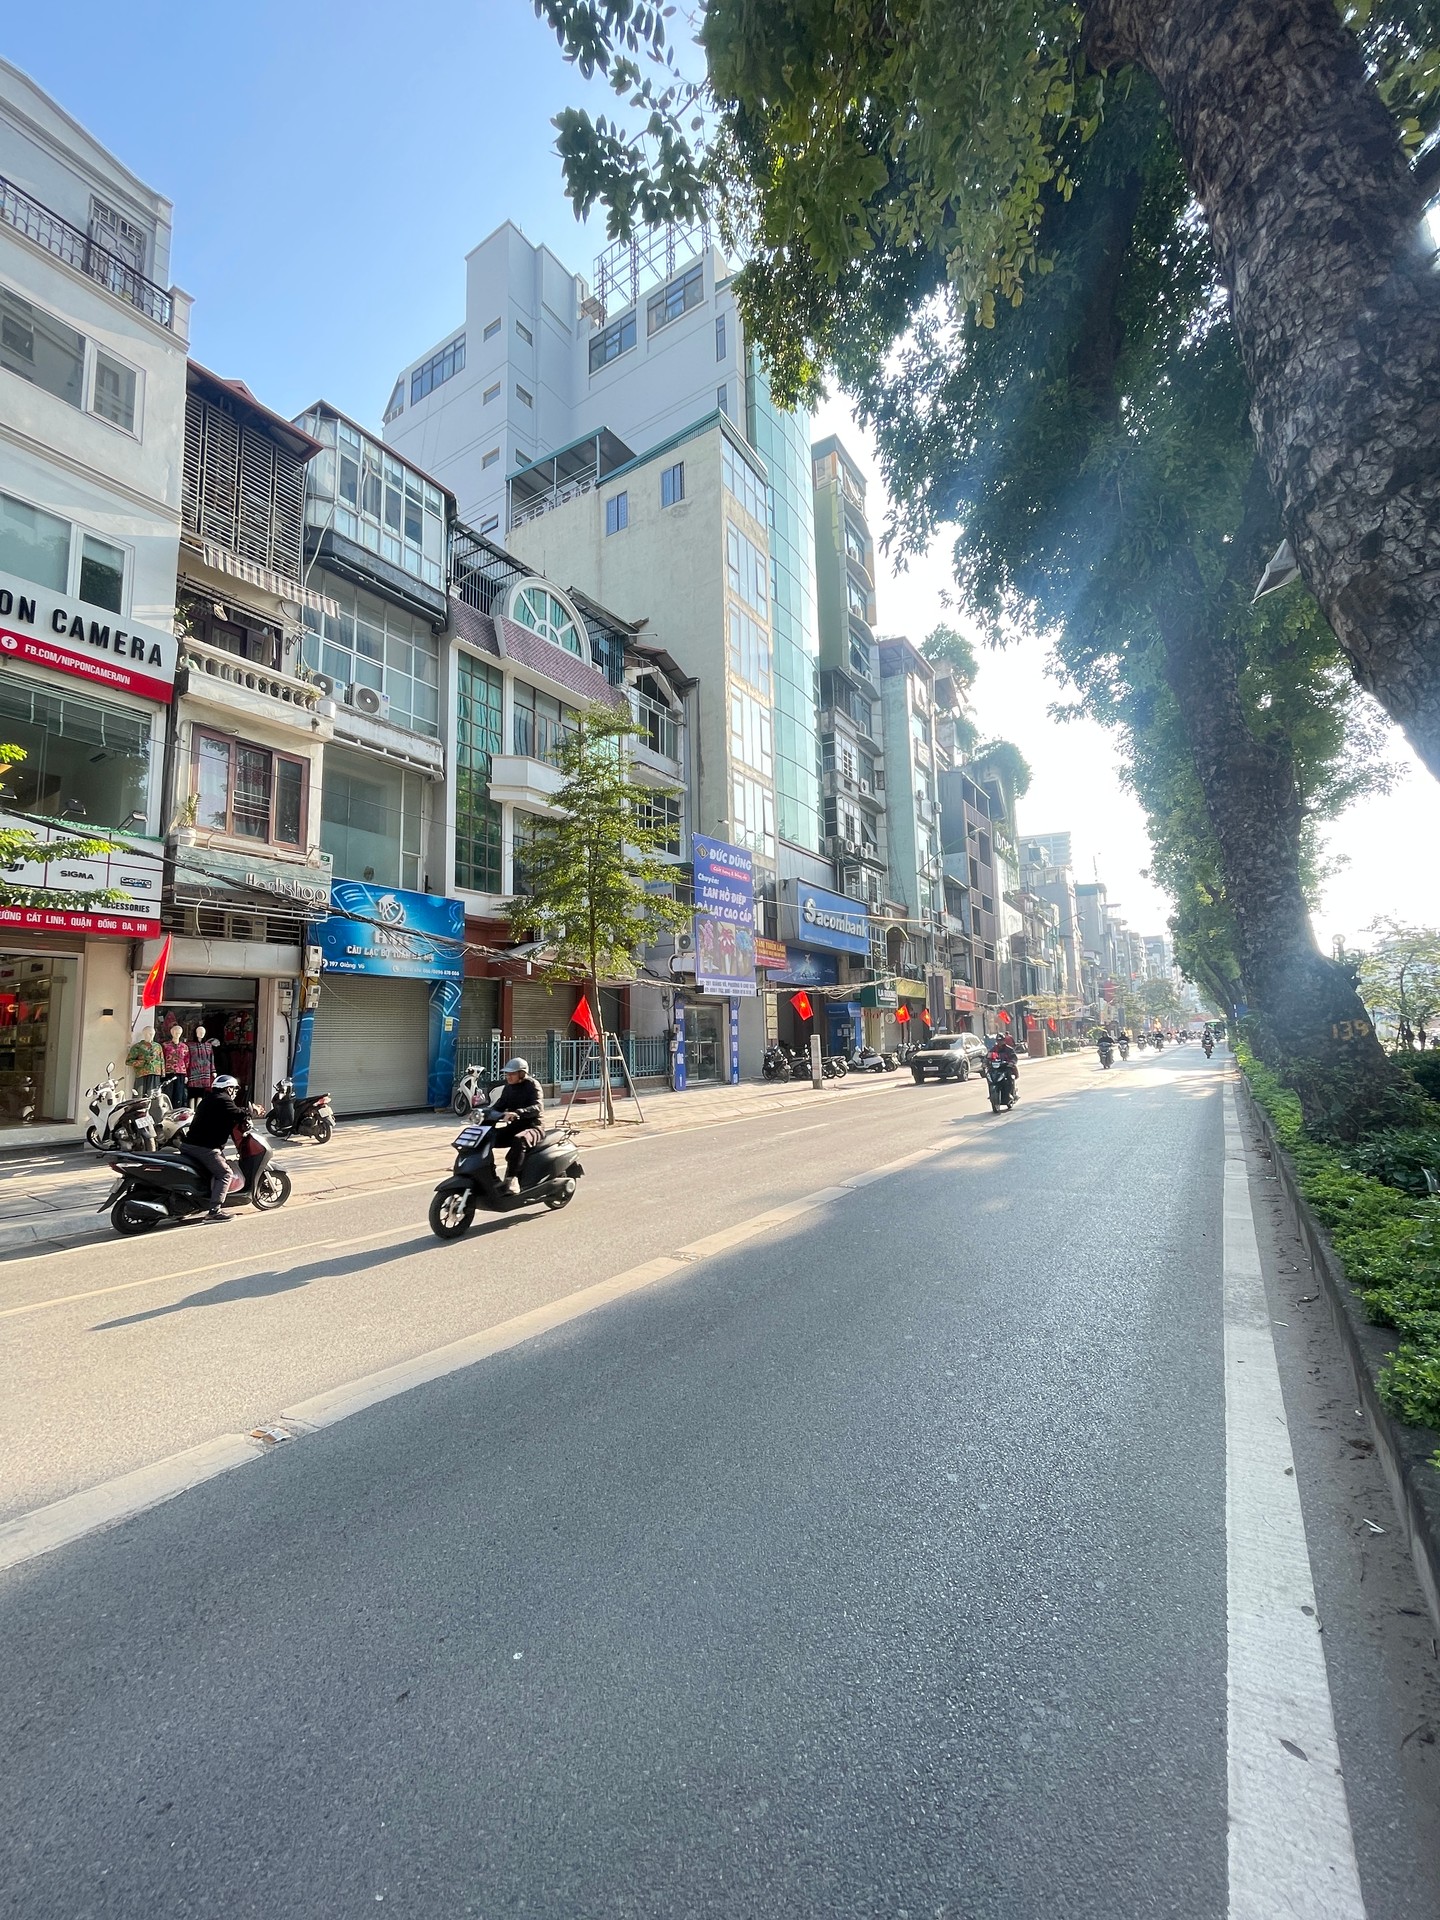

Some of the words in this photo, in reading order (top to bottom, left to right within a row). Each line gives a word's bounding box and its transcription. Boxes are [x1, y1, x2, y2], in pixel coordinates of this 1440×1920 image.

[51, 608, 162, 667] CAMERA
[24, 643, 131, 685] FB.COM/NIPPONCAMERAVN
[709, 848, 728, 864] ĐỨC
[728, 854, 752, 871] DŨNG
[60, 870, 95, 880] SIGMA
[702, 885, 719, 900] LAN
[719, 886, 730, 902] HỒ
[26, 911, 42, 923] CÁT
[45, 916, 67, 926] LINH,
[70, 917, 92, 929] QUẬN
[97, 919, 117, 930] ĐỐNG
[122, 923, 134, 932] ĐA,
[136, 923, 148, 932] HN
[723, 907, 739, 920] CAO
[739, 907, 752, 923] CẤP
[803, 897, 867, 938] Sacombank
[346, 944, 362, 955] CÂU
[363, 946, 379, 958] LẠC
[1331, 1019, 1370, 1041] 139
